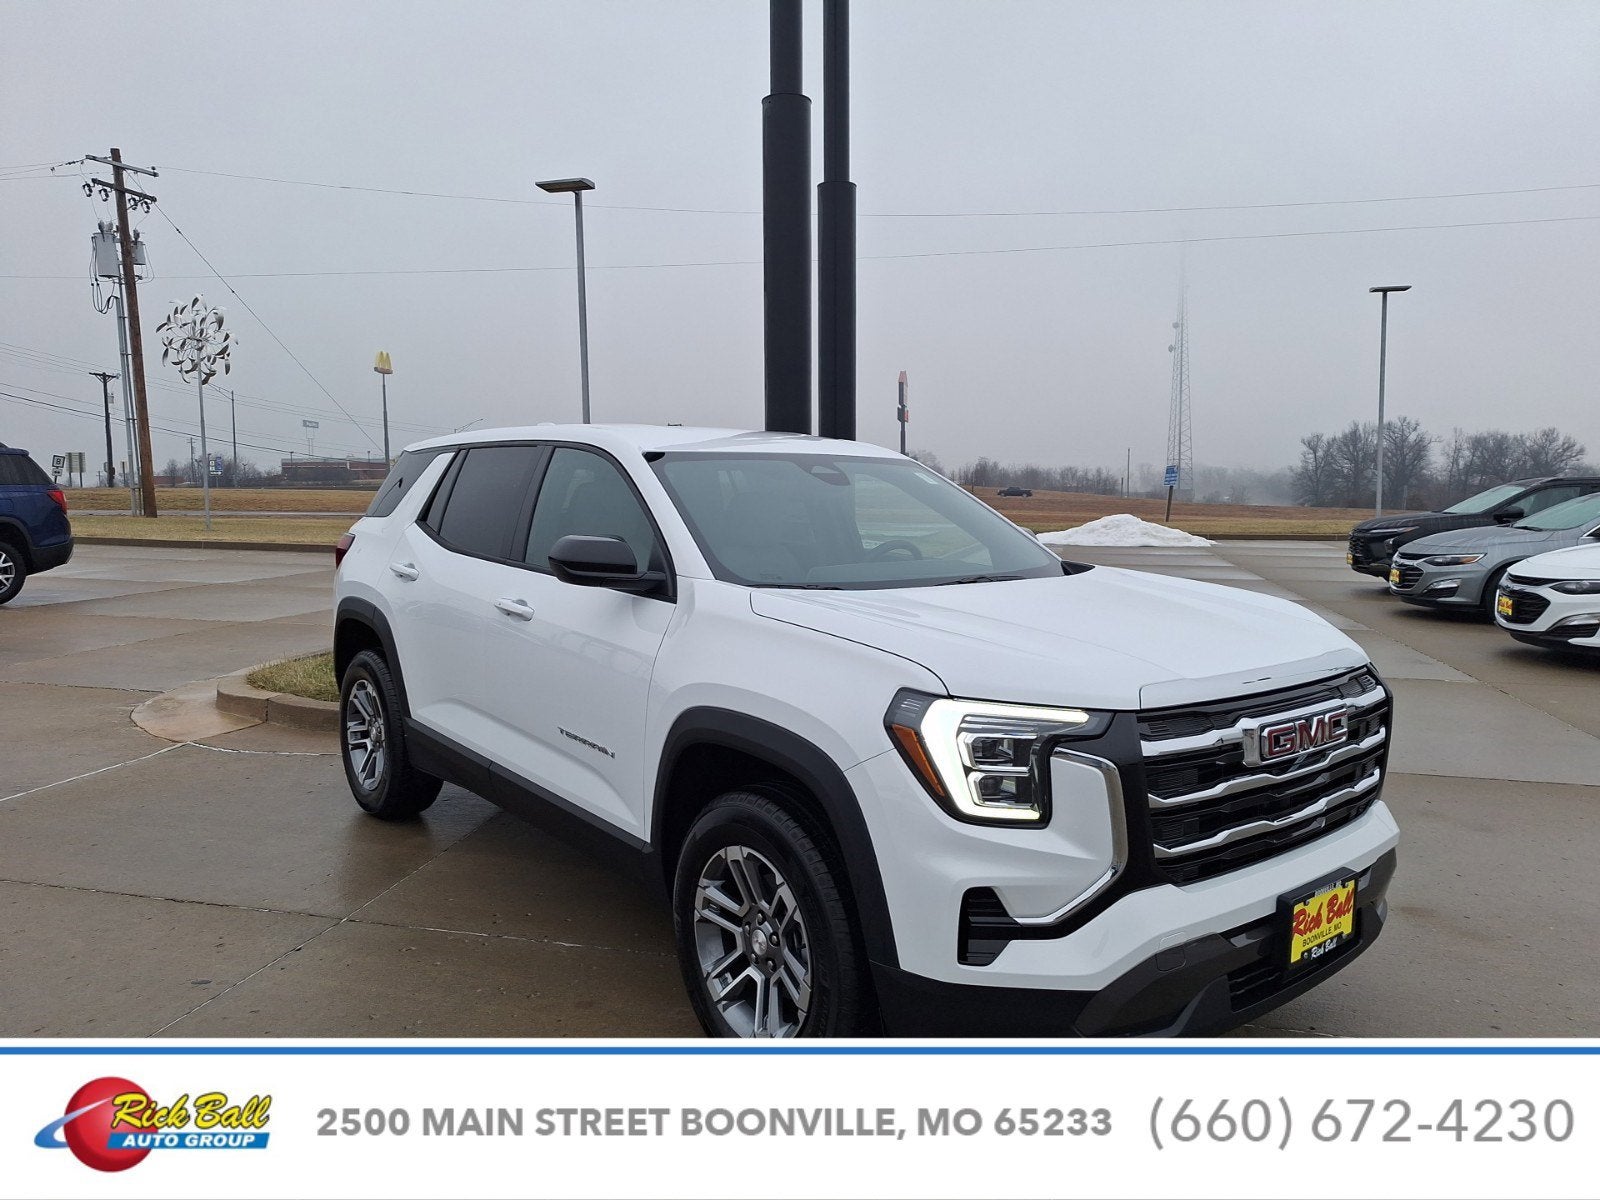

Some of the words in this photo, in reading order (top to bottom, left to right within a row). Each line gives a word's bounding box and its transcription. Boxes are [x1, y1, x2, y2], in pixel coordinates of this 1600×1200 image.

[1262, 708, 1348, 758] GMC
[1293, 902, 1323, 936] Rick
[1326, 888, 1355, 924] Ball
[1302, 926, 1332, 947] BOONVILLE
[1333, 921, 1342, 932] MO
